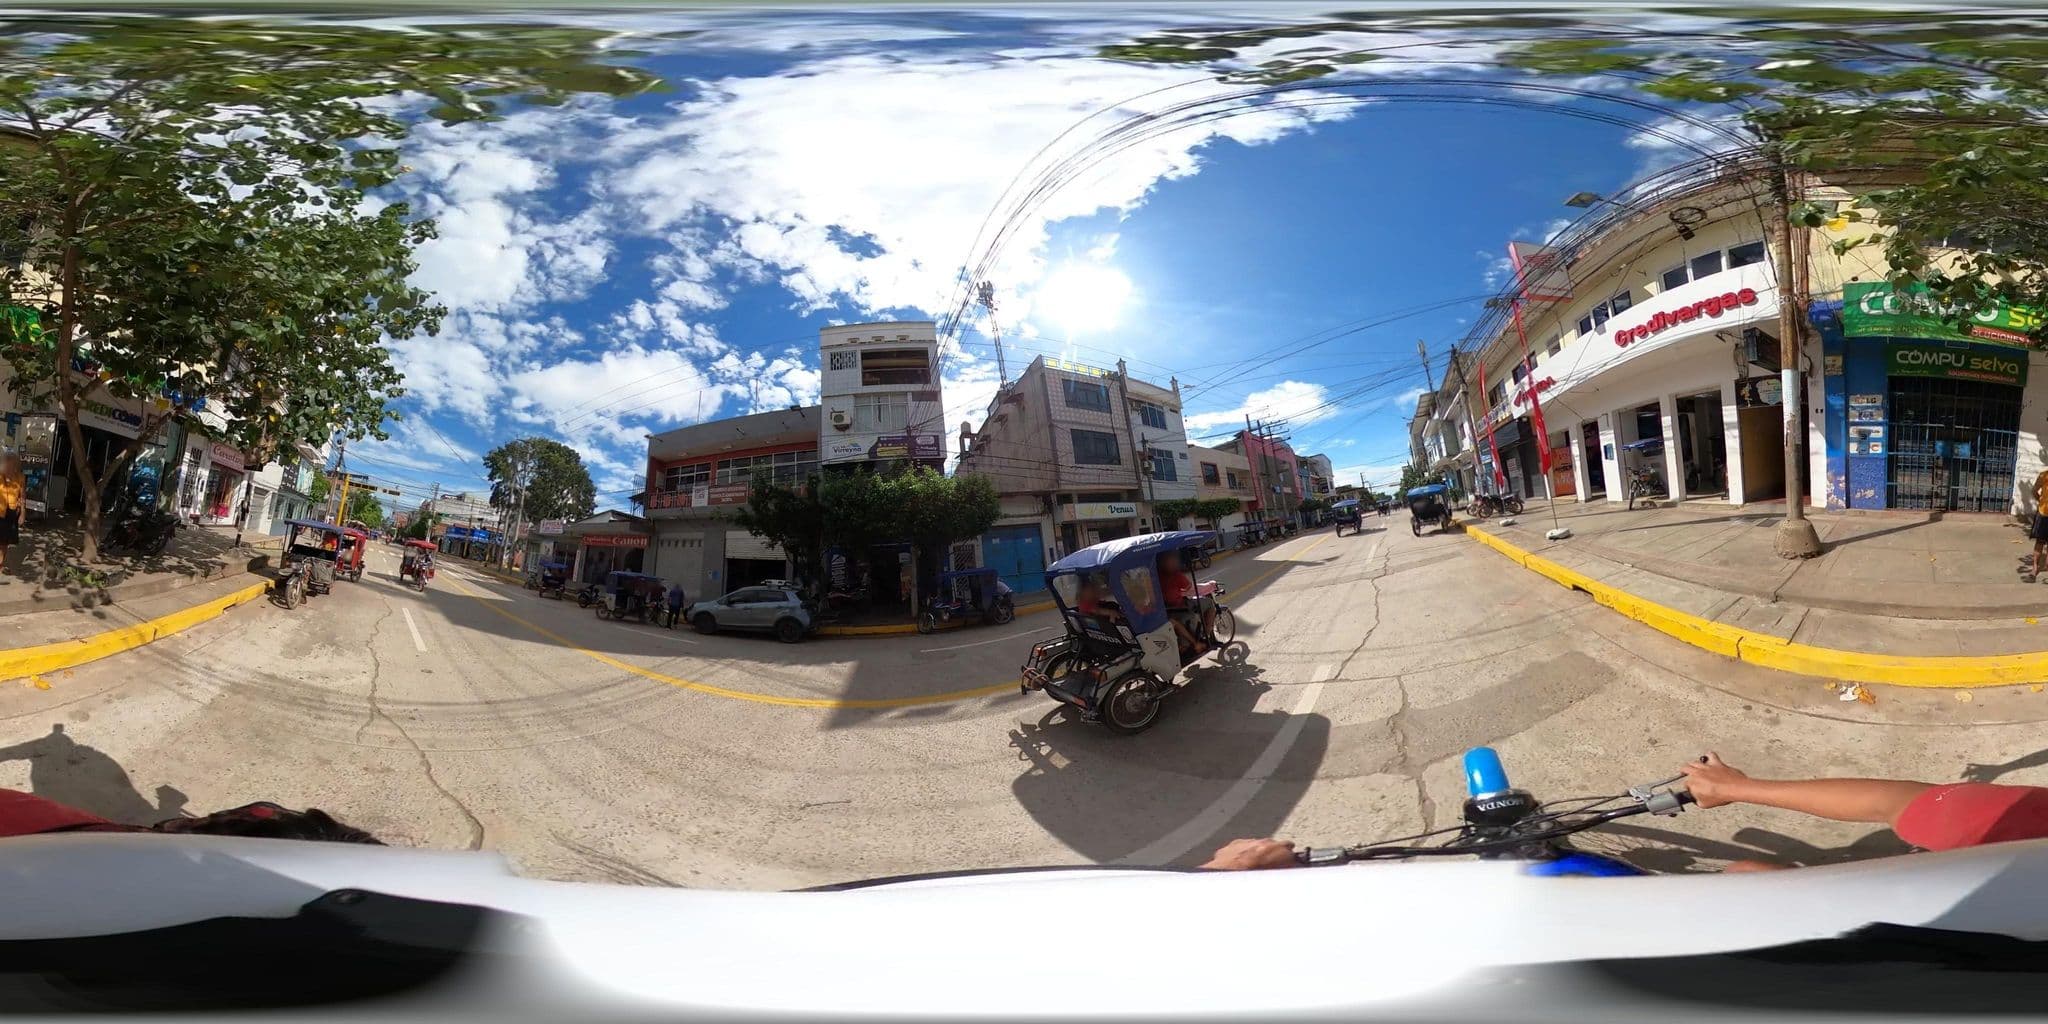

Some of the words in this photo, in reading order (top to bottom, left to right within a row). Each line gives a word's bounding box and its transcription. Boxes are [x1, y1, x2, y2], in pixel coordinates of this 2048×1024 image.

[1615, 287, 1758, 348] Credivargas
[1896, 350, 1965, 367] COMPU
[1970, 357, 2019, 375] selva
[1108, 505, 1134, 514] Venus
[1477, 799, 1525, 811] HONDA
